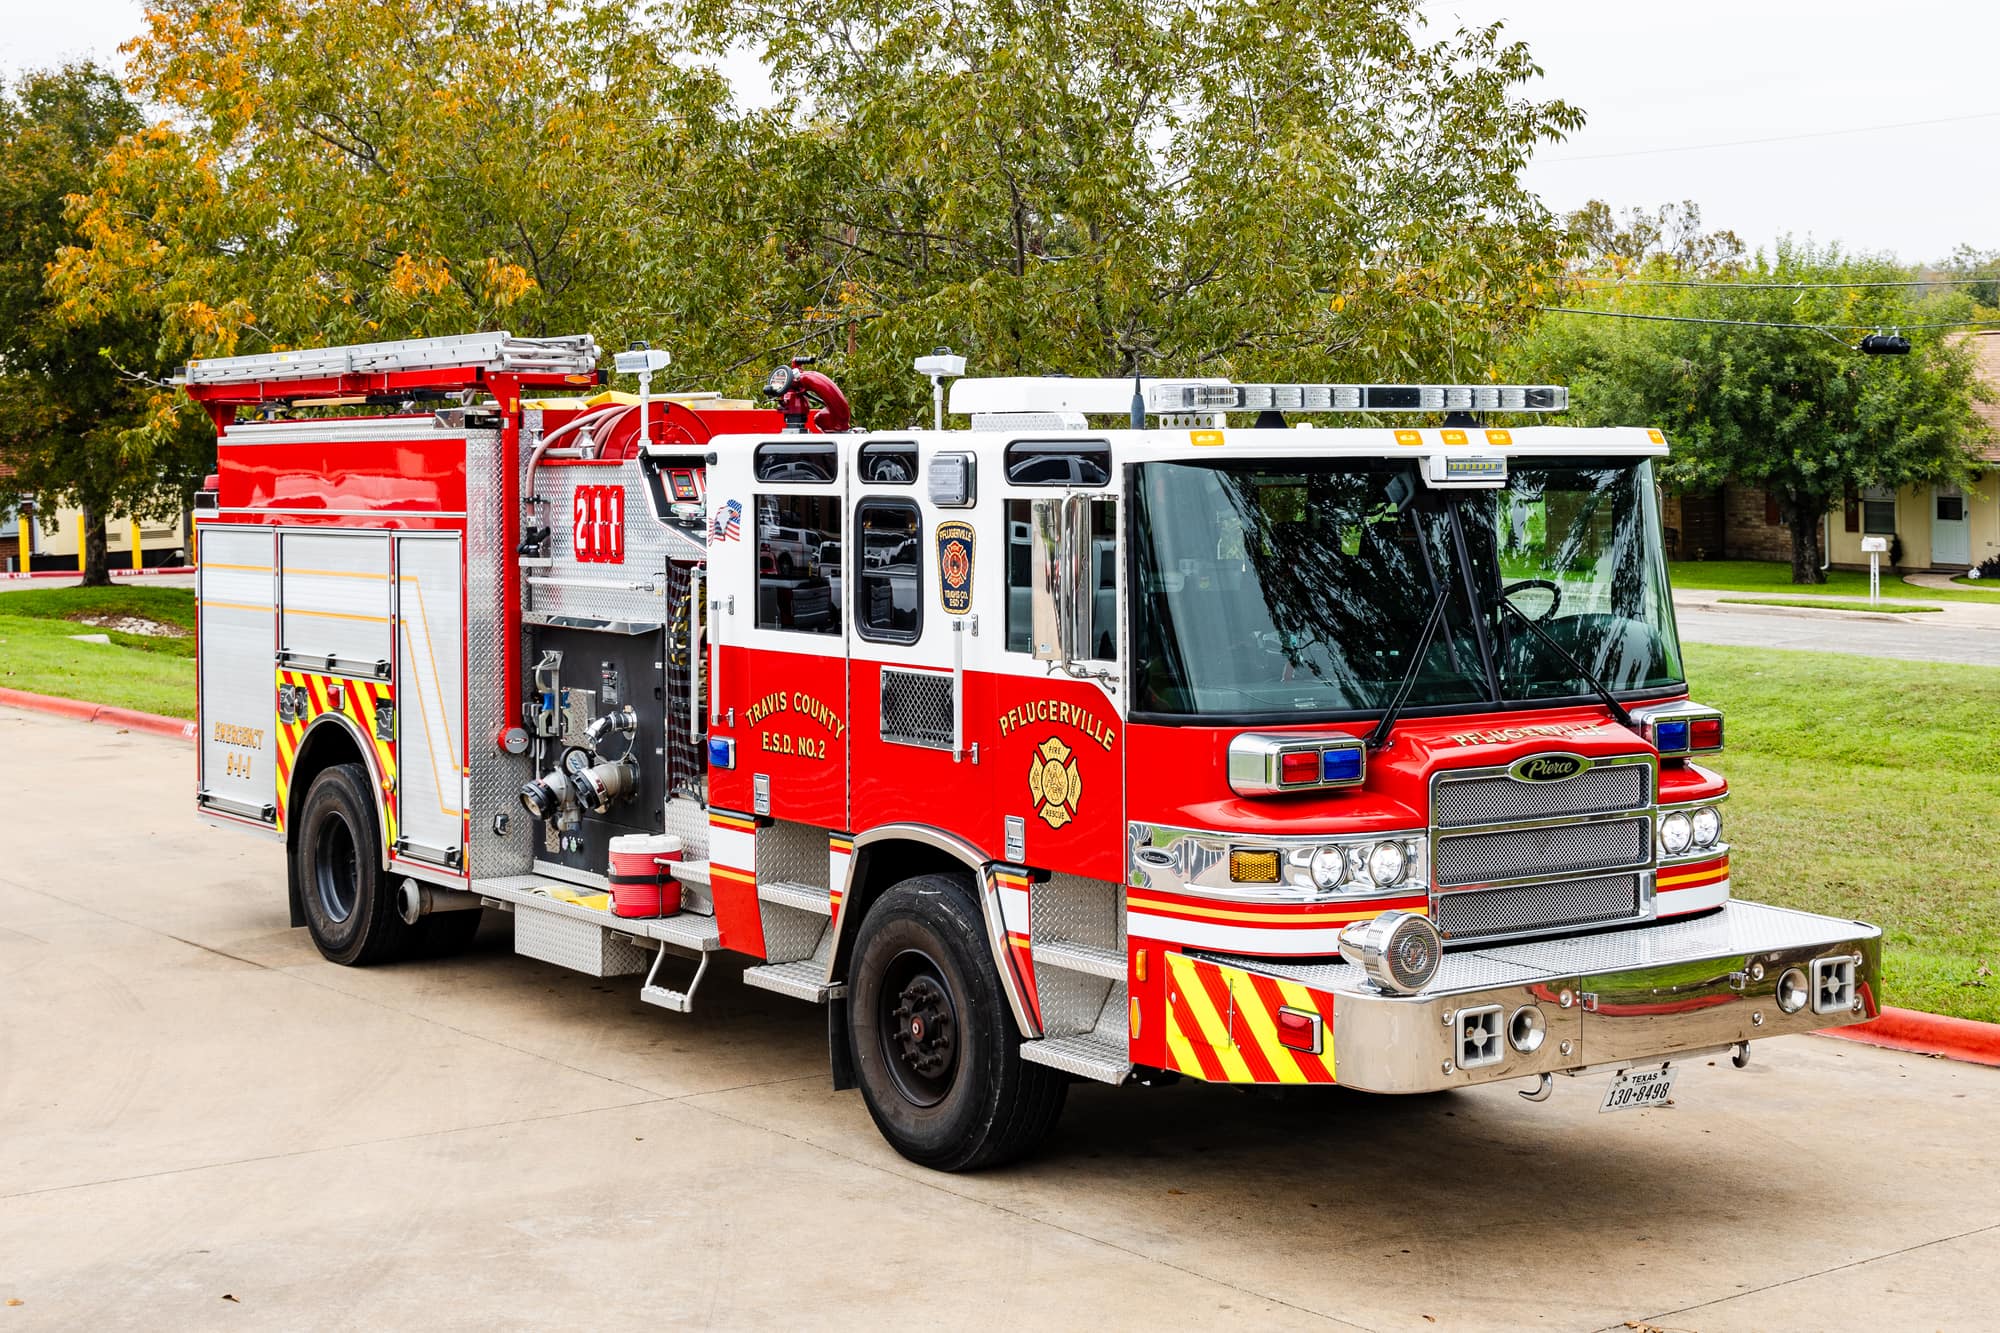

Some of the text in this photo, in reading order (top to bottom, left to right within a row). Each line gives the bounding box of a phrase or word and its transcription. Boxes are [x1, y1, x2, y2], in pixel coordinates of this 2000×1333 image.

[576, 497, 618, 551] 211
[745, 691, 846, 740] TRAVIS COUNTY
[999, 699, 1116, 752] PFLUGERVILLE
[762, 731, 795, 755] E.S.D.
[1451, 724, 1608, 747] PFLUGERVILLE
[1048, 746, 1061, 755] FIRE
[226, 751, 252, 779] 9-1-1
[1527, 759, 1574, 779] Pierce
[1045, 808, 1066, 820] RESCUE
[1632, 1073, 1658, 1083] TEXAS
